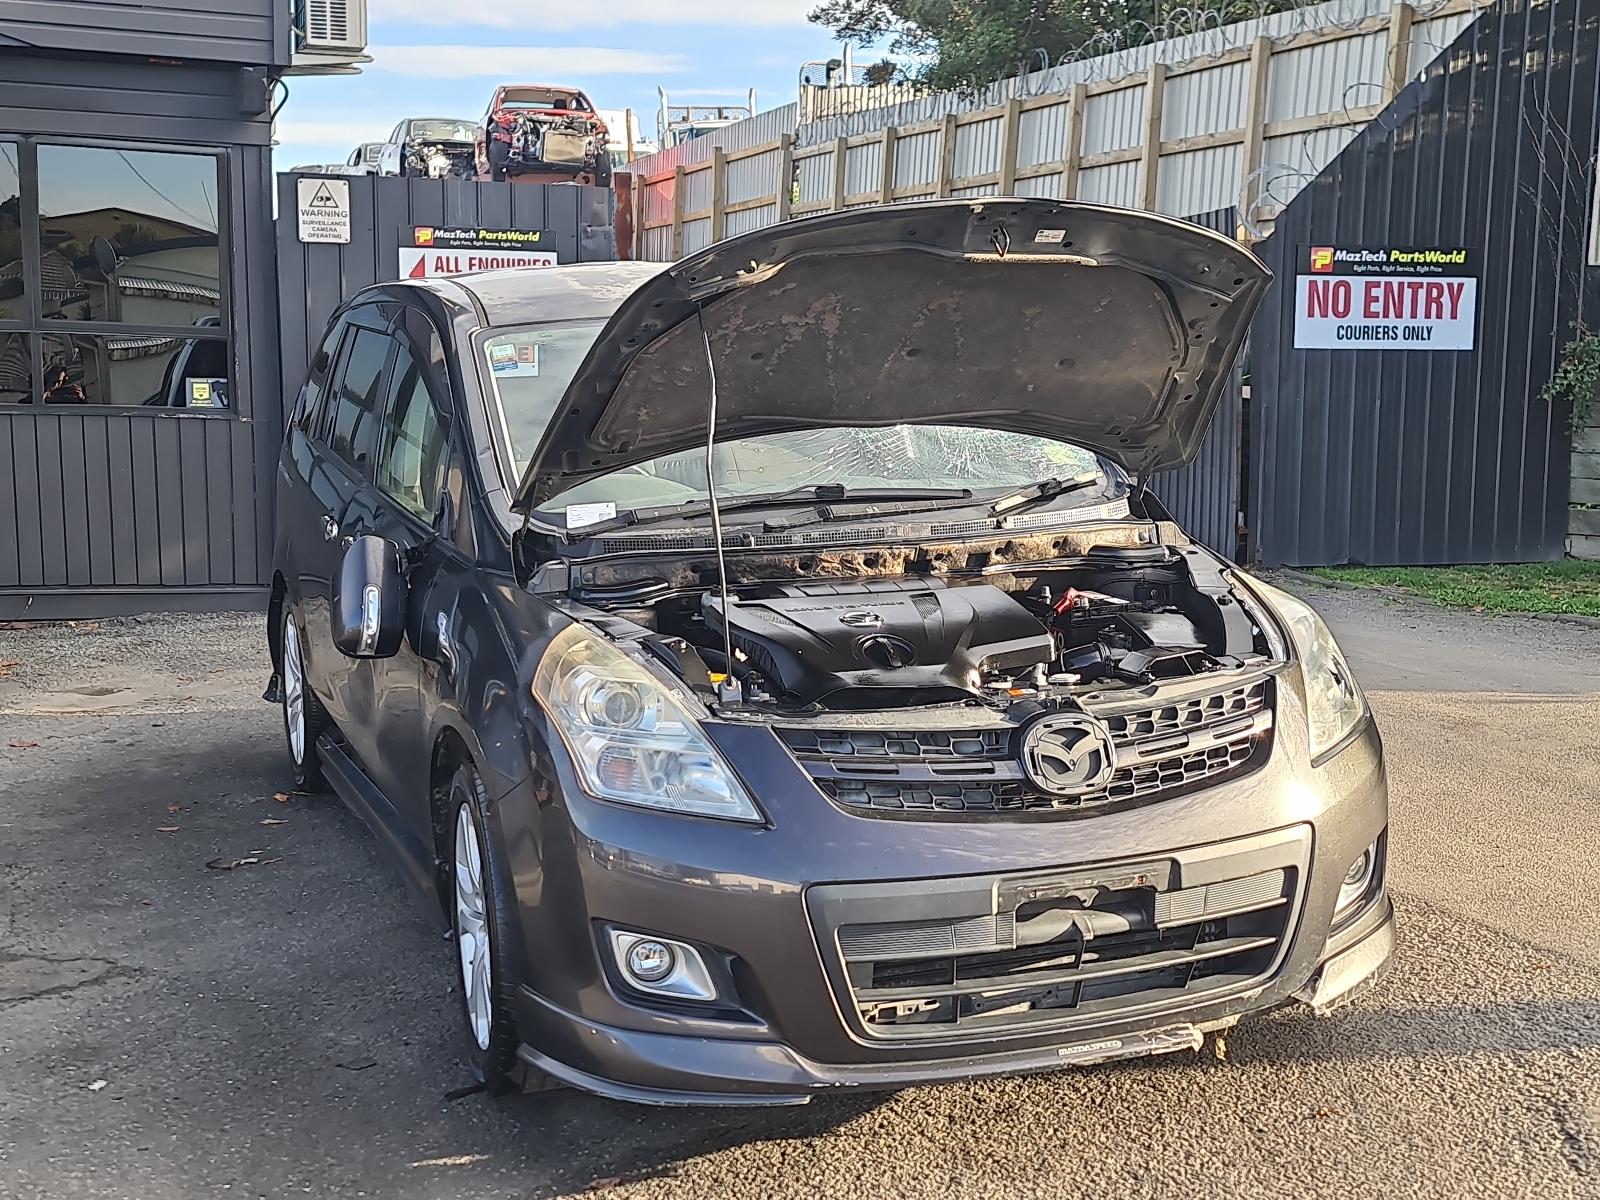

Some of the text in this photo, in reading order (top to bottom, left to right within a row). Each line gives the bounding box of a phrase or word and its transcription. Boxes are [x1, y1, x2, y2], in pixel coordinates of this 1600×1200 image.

[301, 209, 348, 218] WARNING
[434, 229, 540, 241] MazTech PartsWorld
[1334, 249, 1466, 263] MazTech PartsWorld
[433, 255, 463, 273] ALL
[1307, 279, 1465, 320] NO ENTRY
[1336, 325, 1434, 341] COURIERS ONLY
